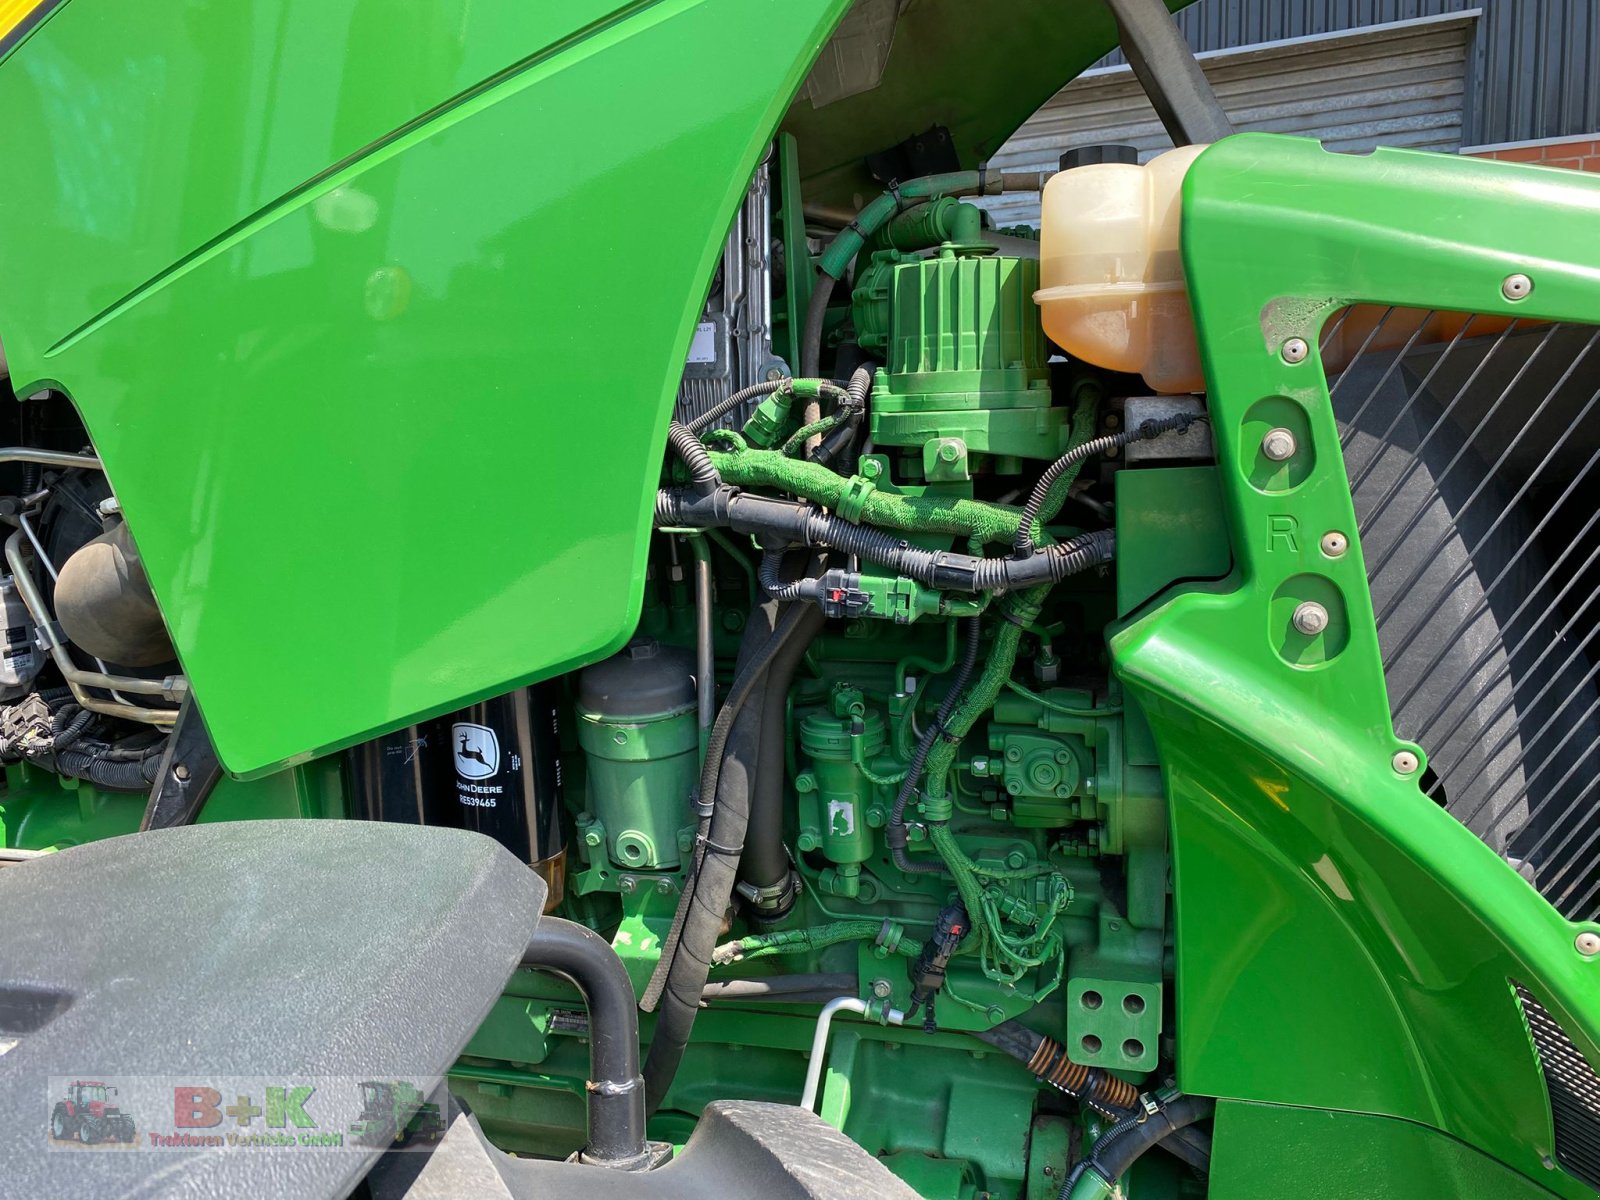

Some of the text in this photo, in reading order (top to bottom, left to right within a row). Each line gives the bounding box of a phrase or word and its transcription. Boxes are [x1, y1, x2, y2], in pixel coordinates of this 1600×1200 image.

[1266, 514, 1298, 553] R
[470, 784, 503, 794] DEERE
[459, 794, 496, 808] RE539465
